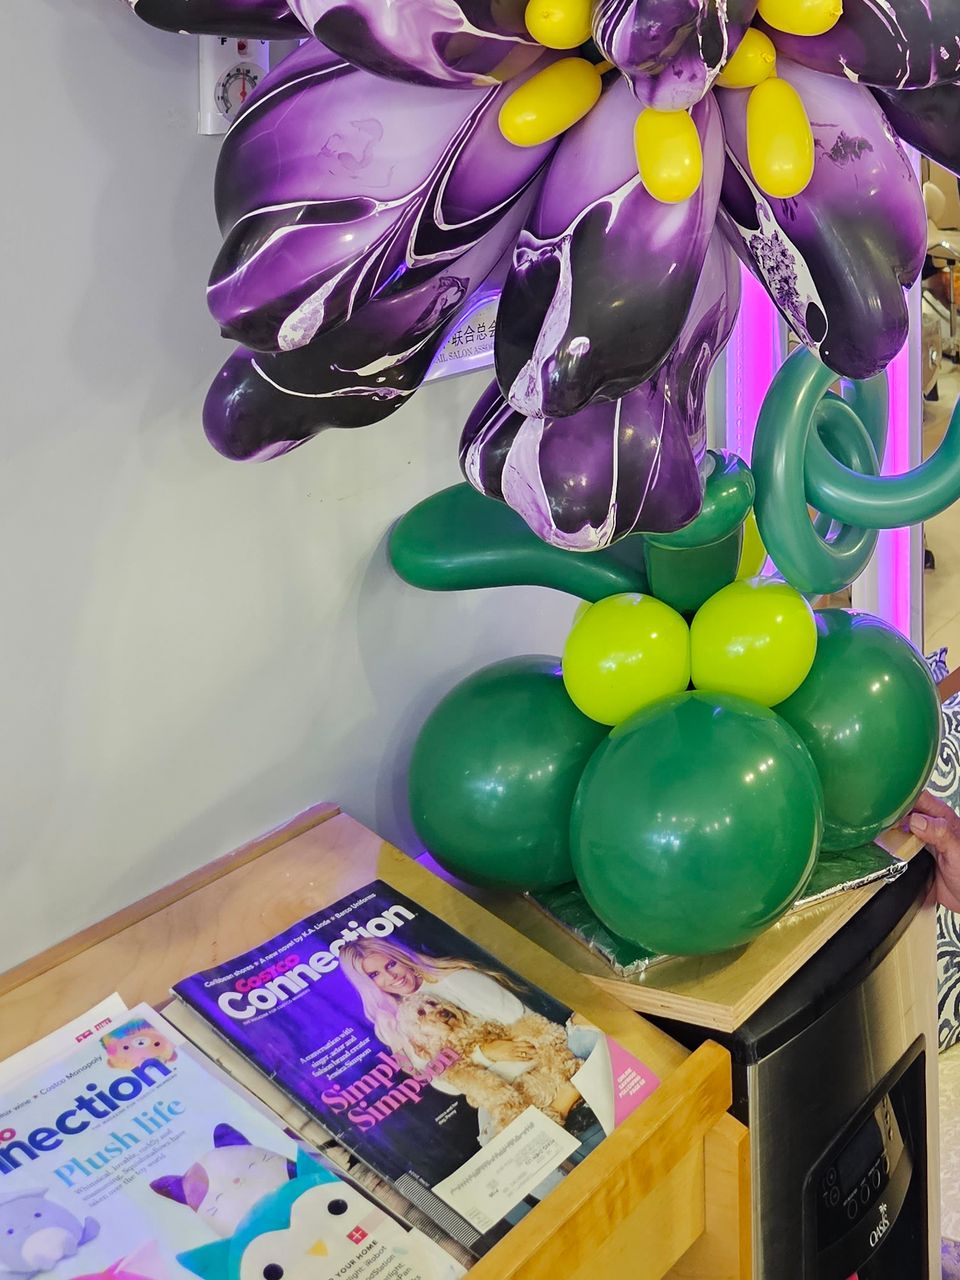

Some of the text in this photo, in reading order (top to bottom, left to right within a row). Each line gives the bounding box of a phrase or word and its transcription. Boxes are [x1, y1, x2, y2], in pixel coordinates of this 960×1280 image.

[444, 320, 497, 349] 联合总会
[435, 353, 449, 365] AIL
[448, 346, 473, 360] SALON
[218, 904, 416, 1020] Connection
[65, 1055, 103, 1080] Monopoly
[321, 1050, 414, 1116] Simply
[347, 1046, 461, 1132] Simpson
[54, 1131, 141, 1188] Plush
[131, 1100, 186, 1135] life
[869, 1215, 890, 1247] OASIS
[334, 1239, 378, 1278] YOUR HOME
